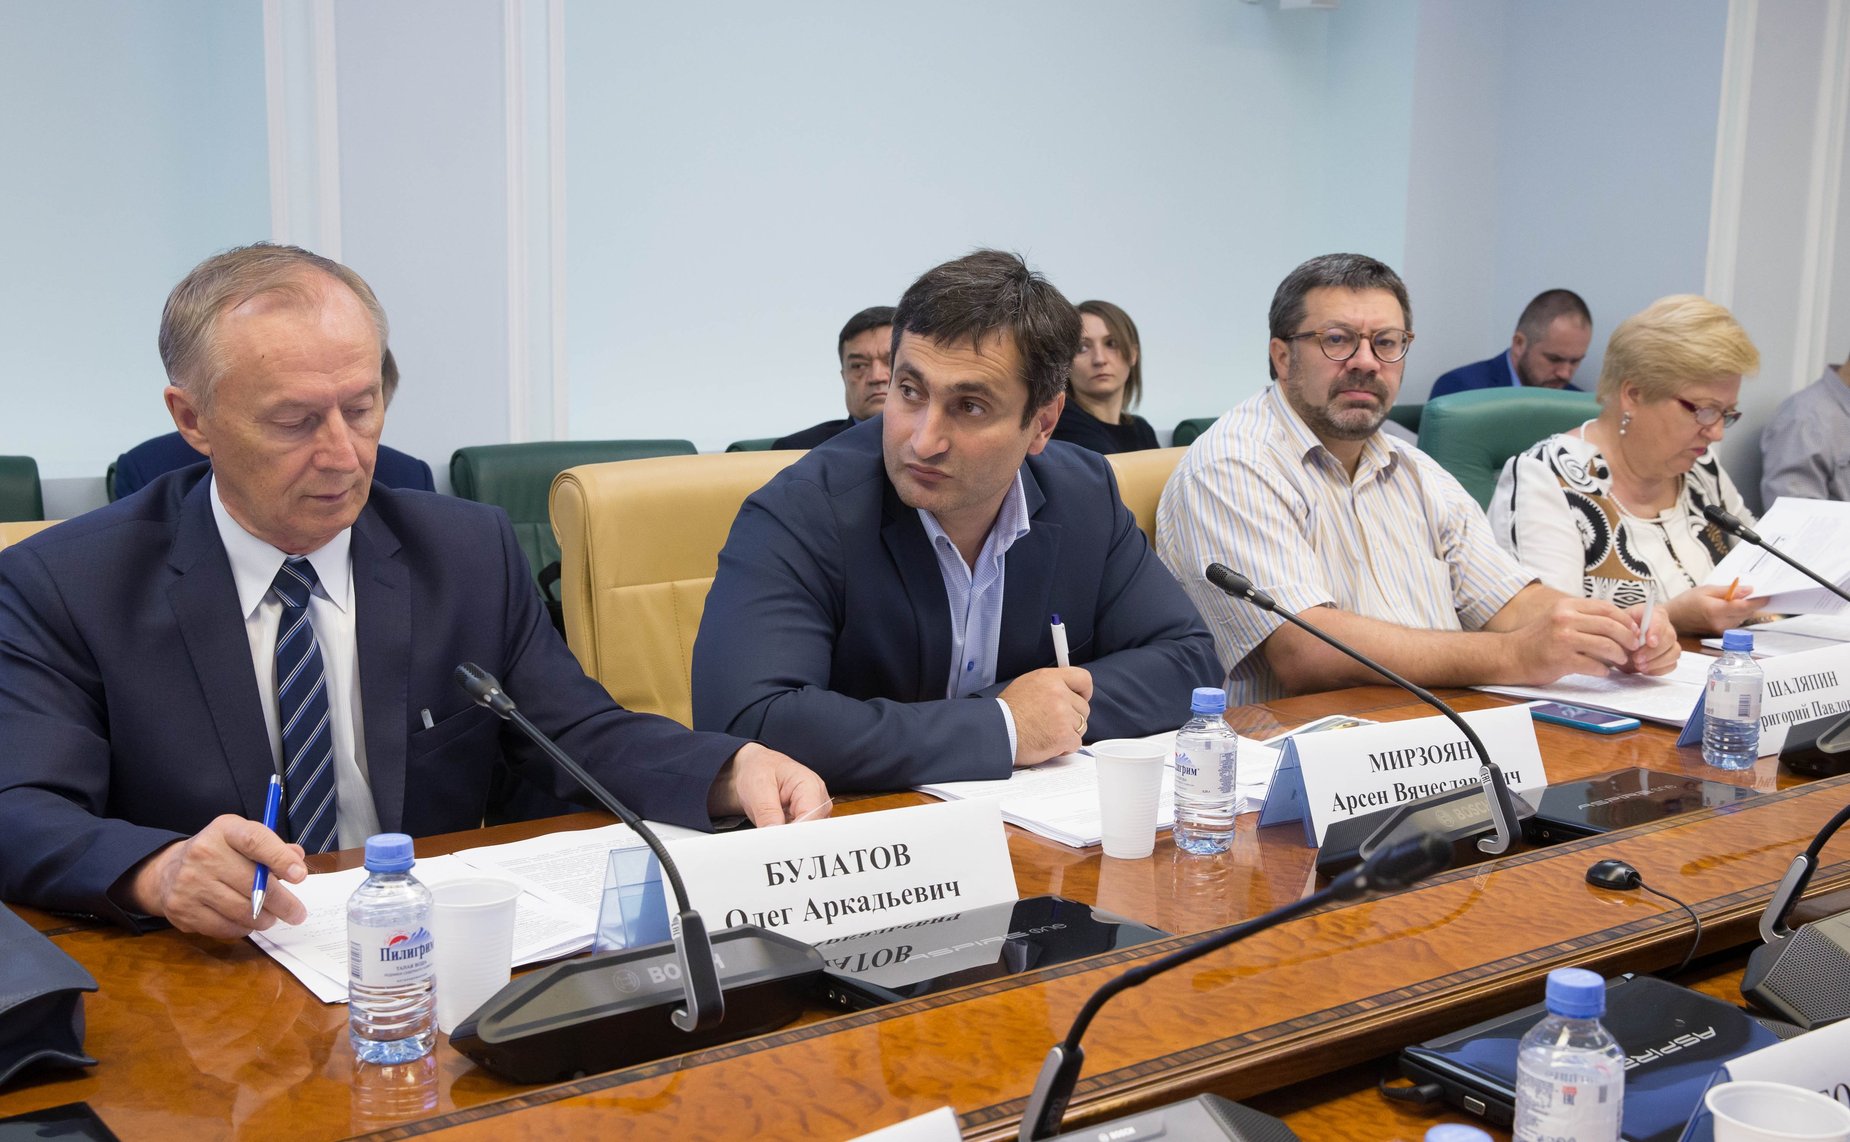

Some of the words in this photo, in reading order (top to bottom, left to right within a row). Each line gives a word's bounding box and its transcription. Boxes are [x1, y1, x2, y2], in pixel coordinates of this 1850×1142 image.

[1767, 671, 1839, 697] ШАЛЯПИН
[1760, 704, 1811, 732] ригорий
[1368, 740, 1475, 773] МИРЗОЯН
[1332, 789, 1390, 815] Арсен
[763, 843, 912, 887] БУЛАТОВ
[725, 906, 794, 929] Олег
[803, 880, 962, 925] Аркадьевич
[904, 931, 1030, 964] ASPIRE
